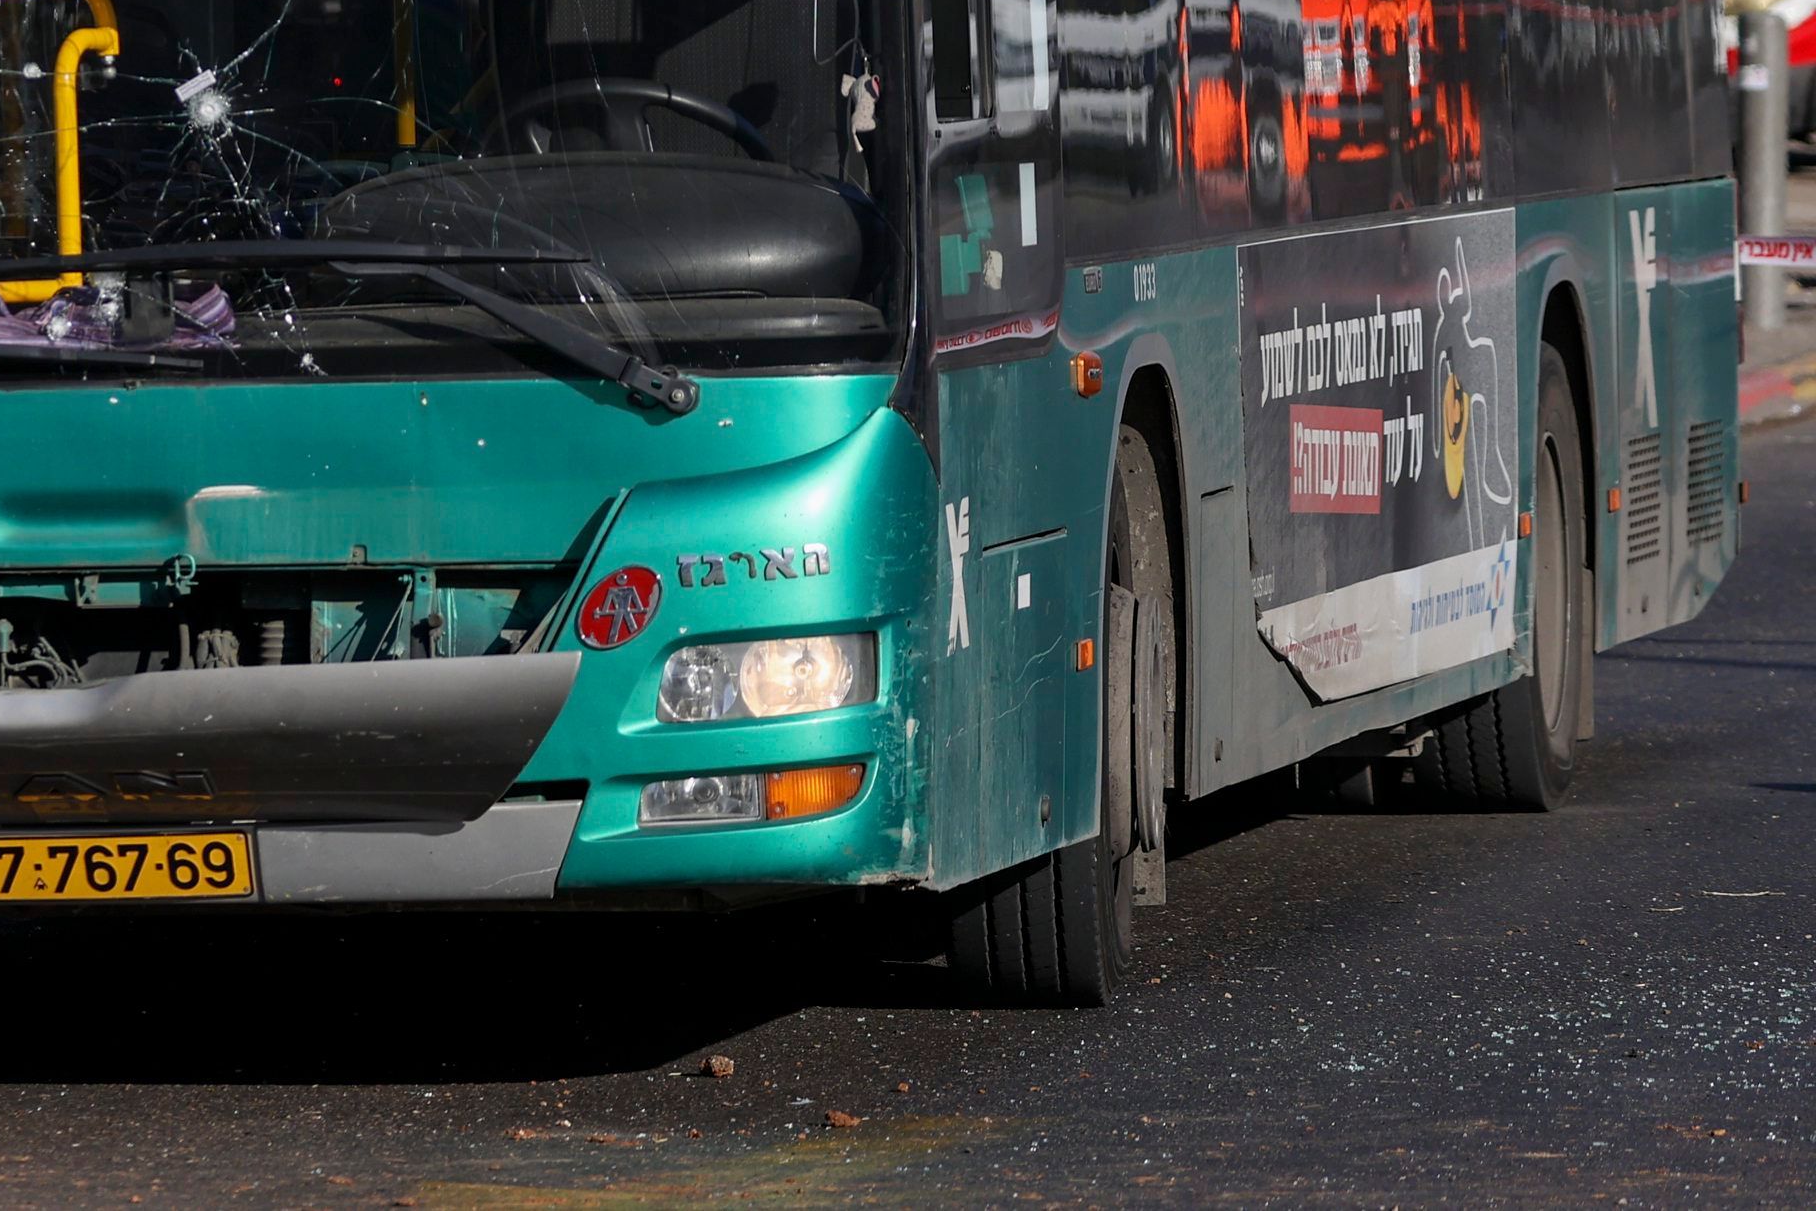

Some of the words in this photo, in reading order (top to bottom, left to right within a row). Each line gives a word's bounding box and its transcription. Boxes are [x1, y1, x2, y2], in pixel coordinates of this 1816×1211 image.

[1306, 302, 1332, 392] לכם
[1334, 317, 1366, 386] נמאס
[1369, 294, 1386, 380] לא
[1342, 430, 1380, 496] תאונת
[1384, 417, 1404, 488] עוד
[1406, 395, 1424, 482] על
[676, 542, 831, 588] הארגז
